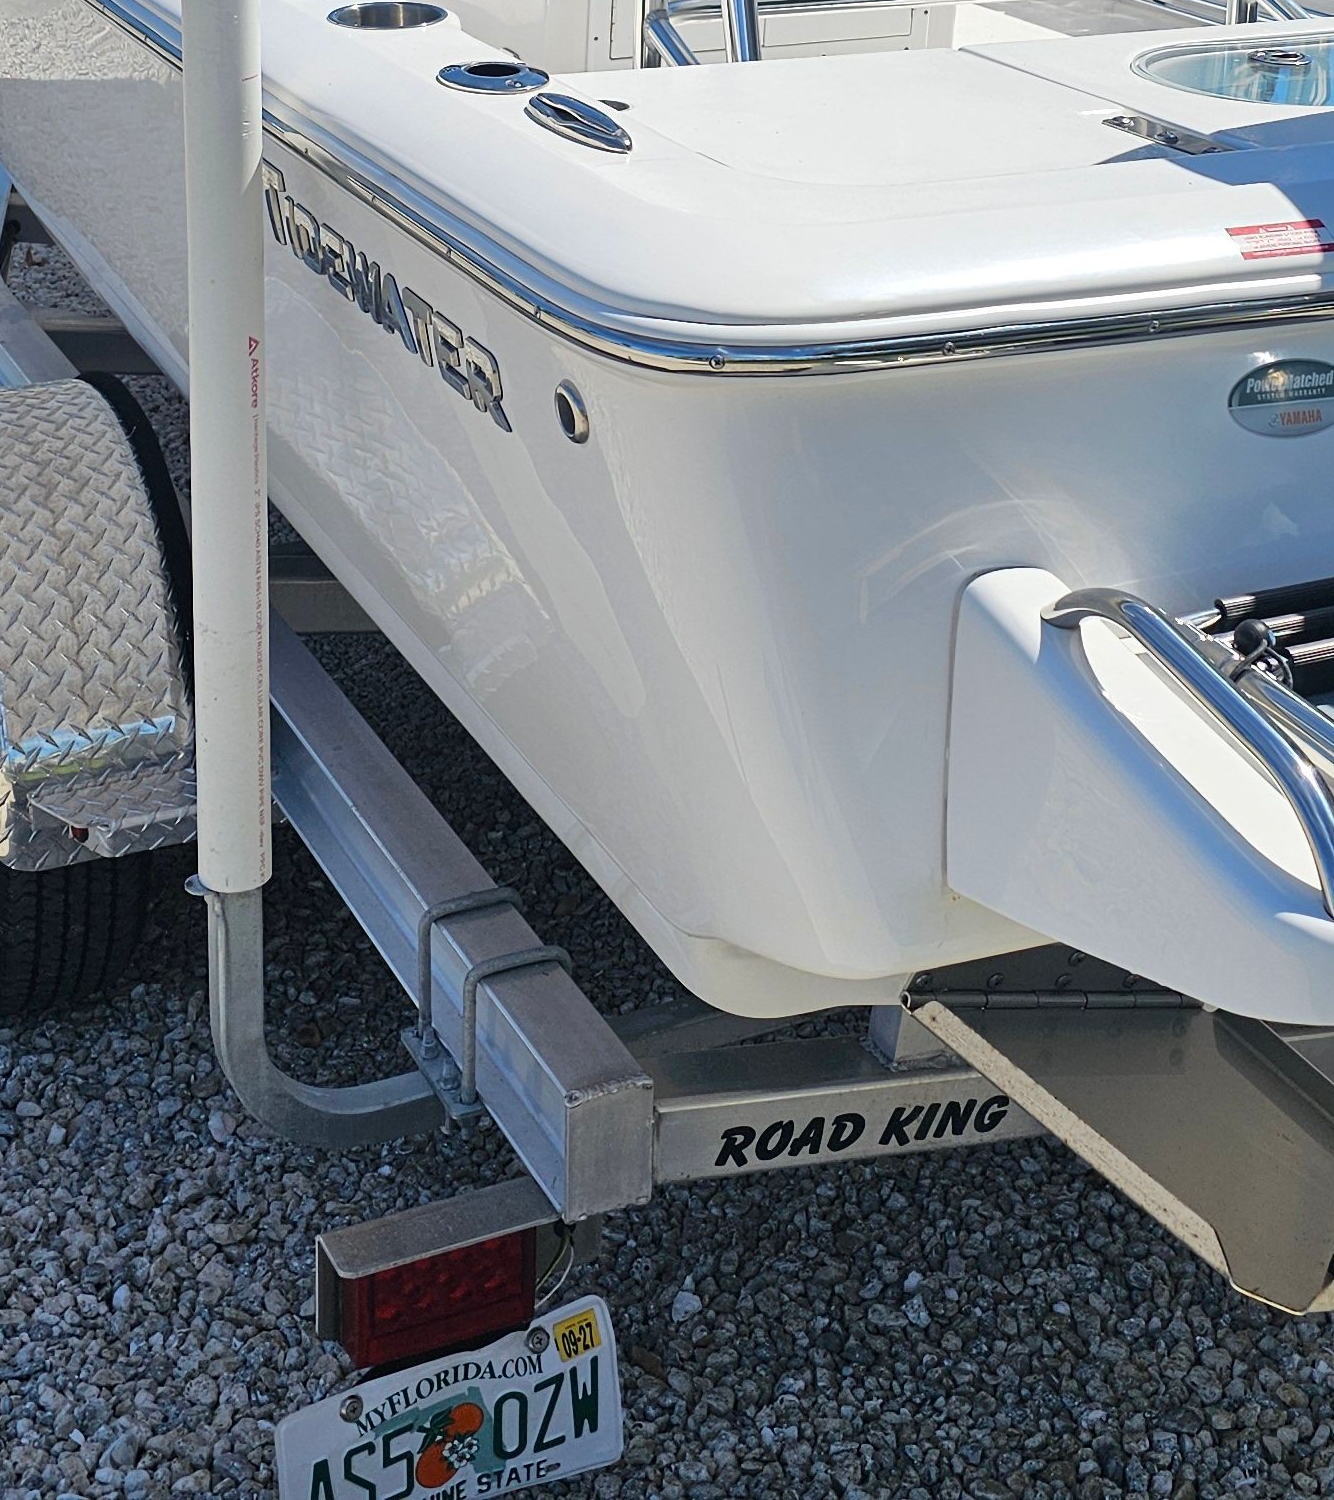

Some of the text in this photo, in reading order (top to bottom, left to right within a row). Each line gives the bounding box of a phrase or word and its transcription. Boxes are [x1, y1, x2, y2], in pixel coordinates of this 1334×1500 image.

[263, 158, 513, 433] TIDEWATER
[250, 357, 260, 409] Atkore
[1279, 408, 1323, 426] YAMAHA
[715, 1094, 1010, 1168] ROAD KING
[353, 1354, 544, 1437] MYFLORIDA.COM
[476, 1458, 548, 1494] STATE
